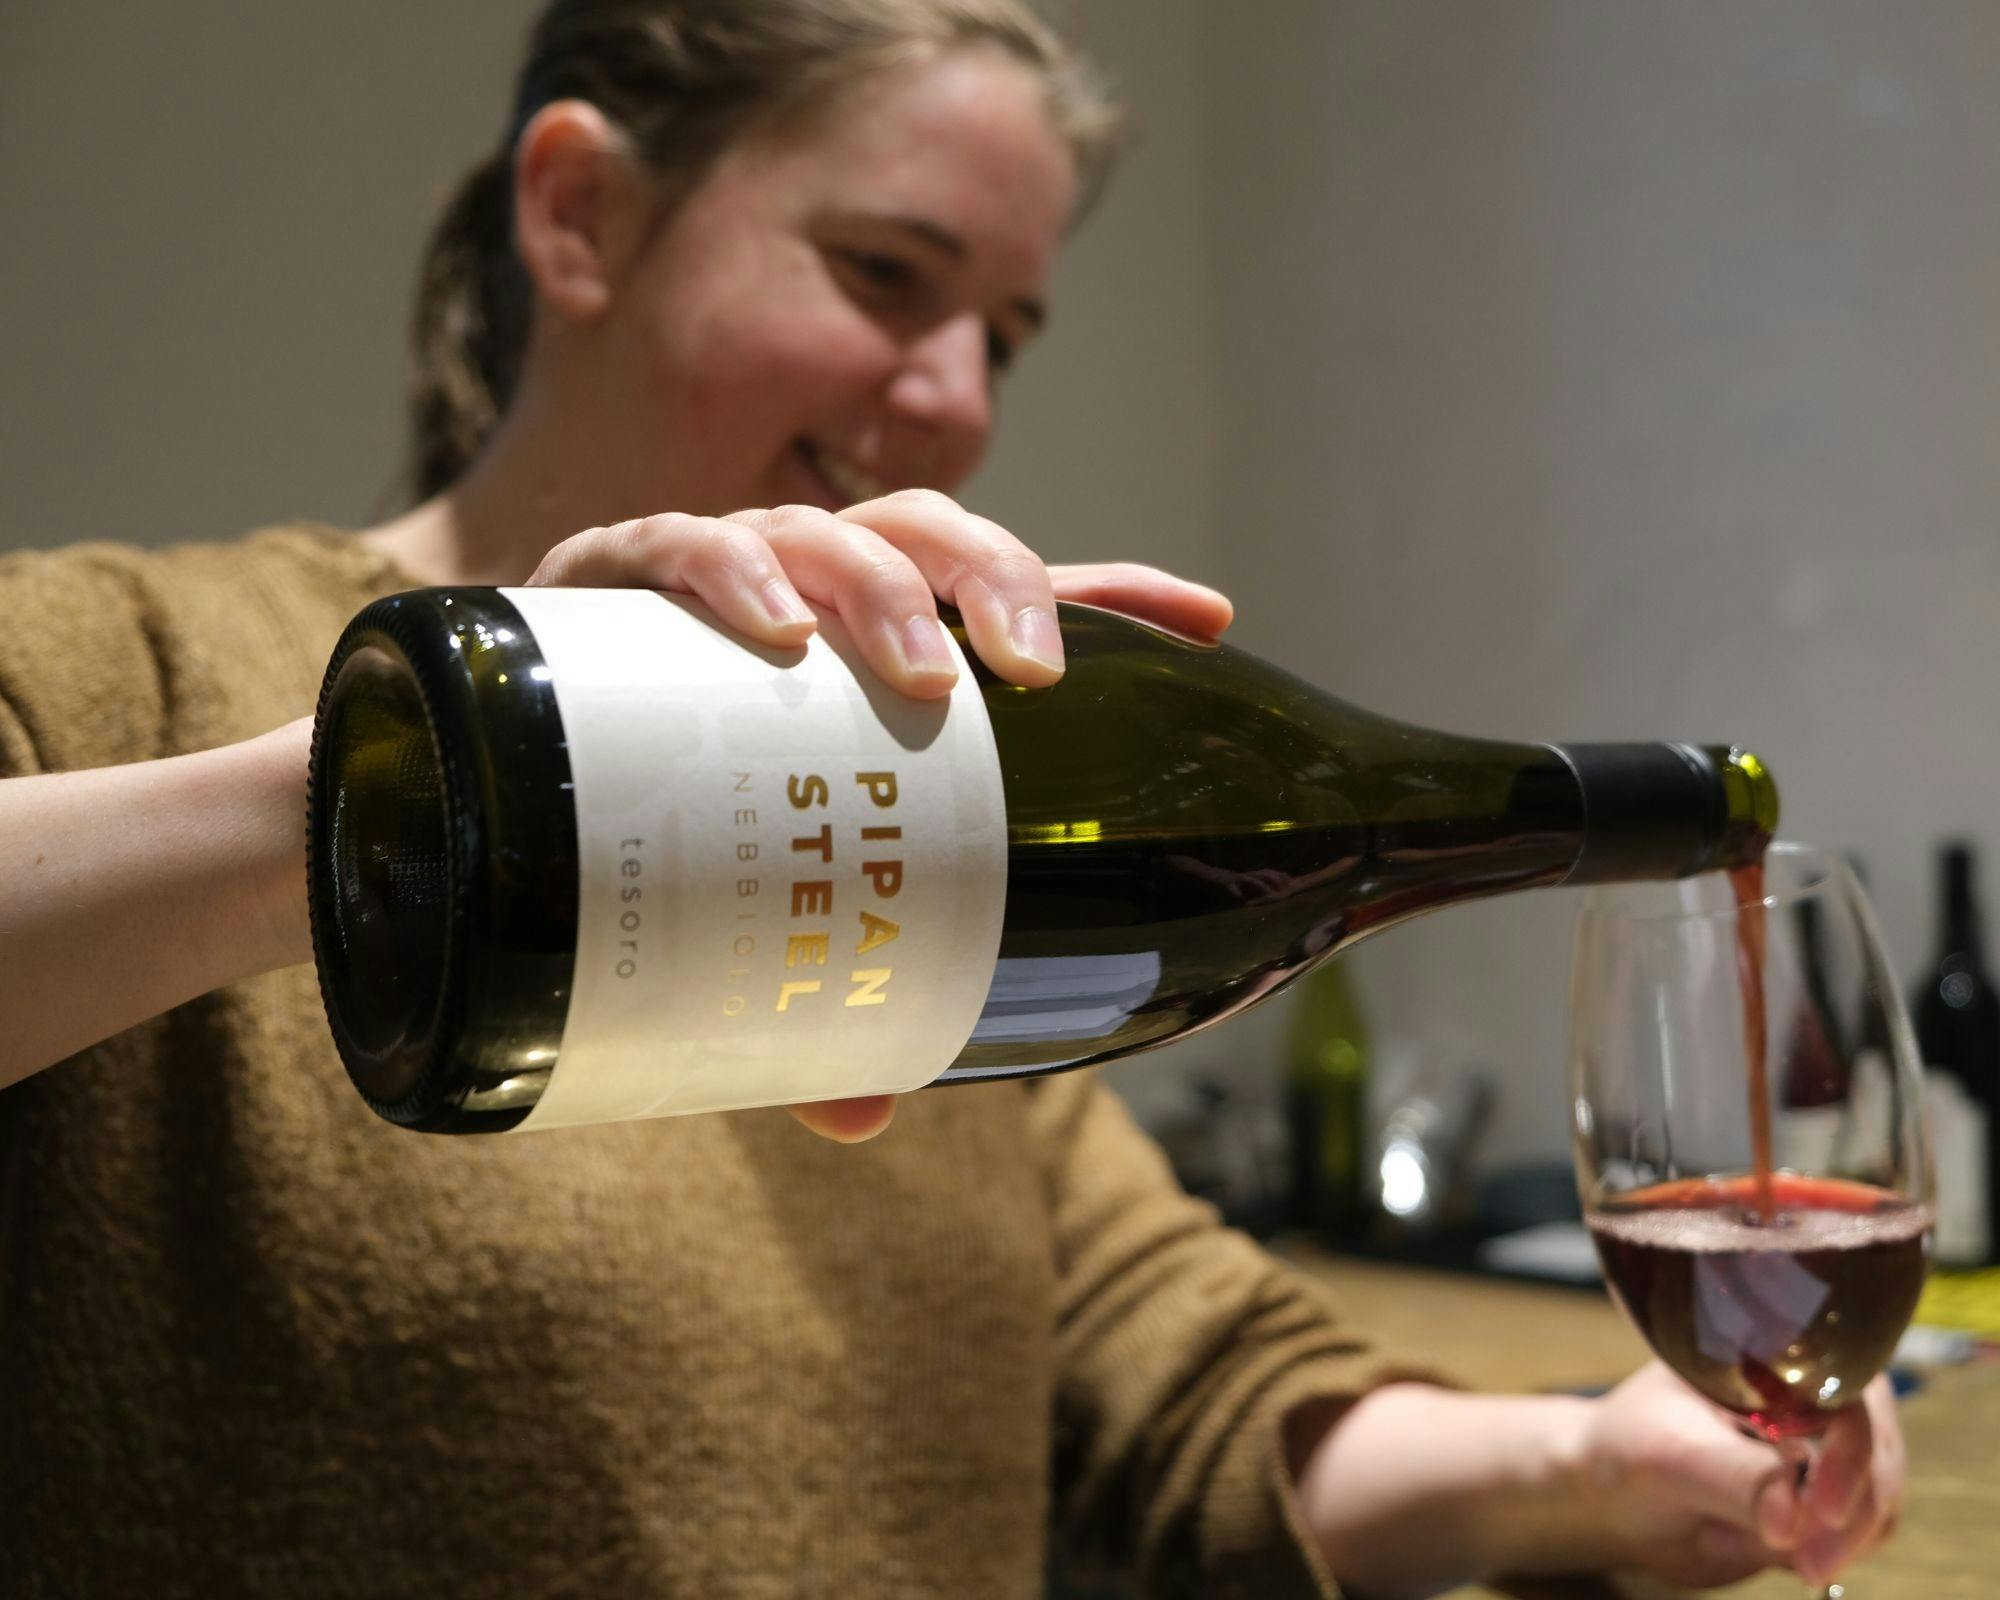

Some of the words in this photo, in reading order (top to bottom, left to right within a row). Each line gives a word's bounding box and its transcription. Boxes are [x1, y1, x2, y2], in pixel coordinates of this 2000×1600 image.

[615, 837, 643, 980] tesoro
[722, 772, 759, 1017] NEBBIOLO
[775, 773, 833, 1012] STEEL
[845, 771, 903, 1007] PIPAN
